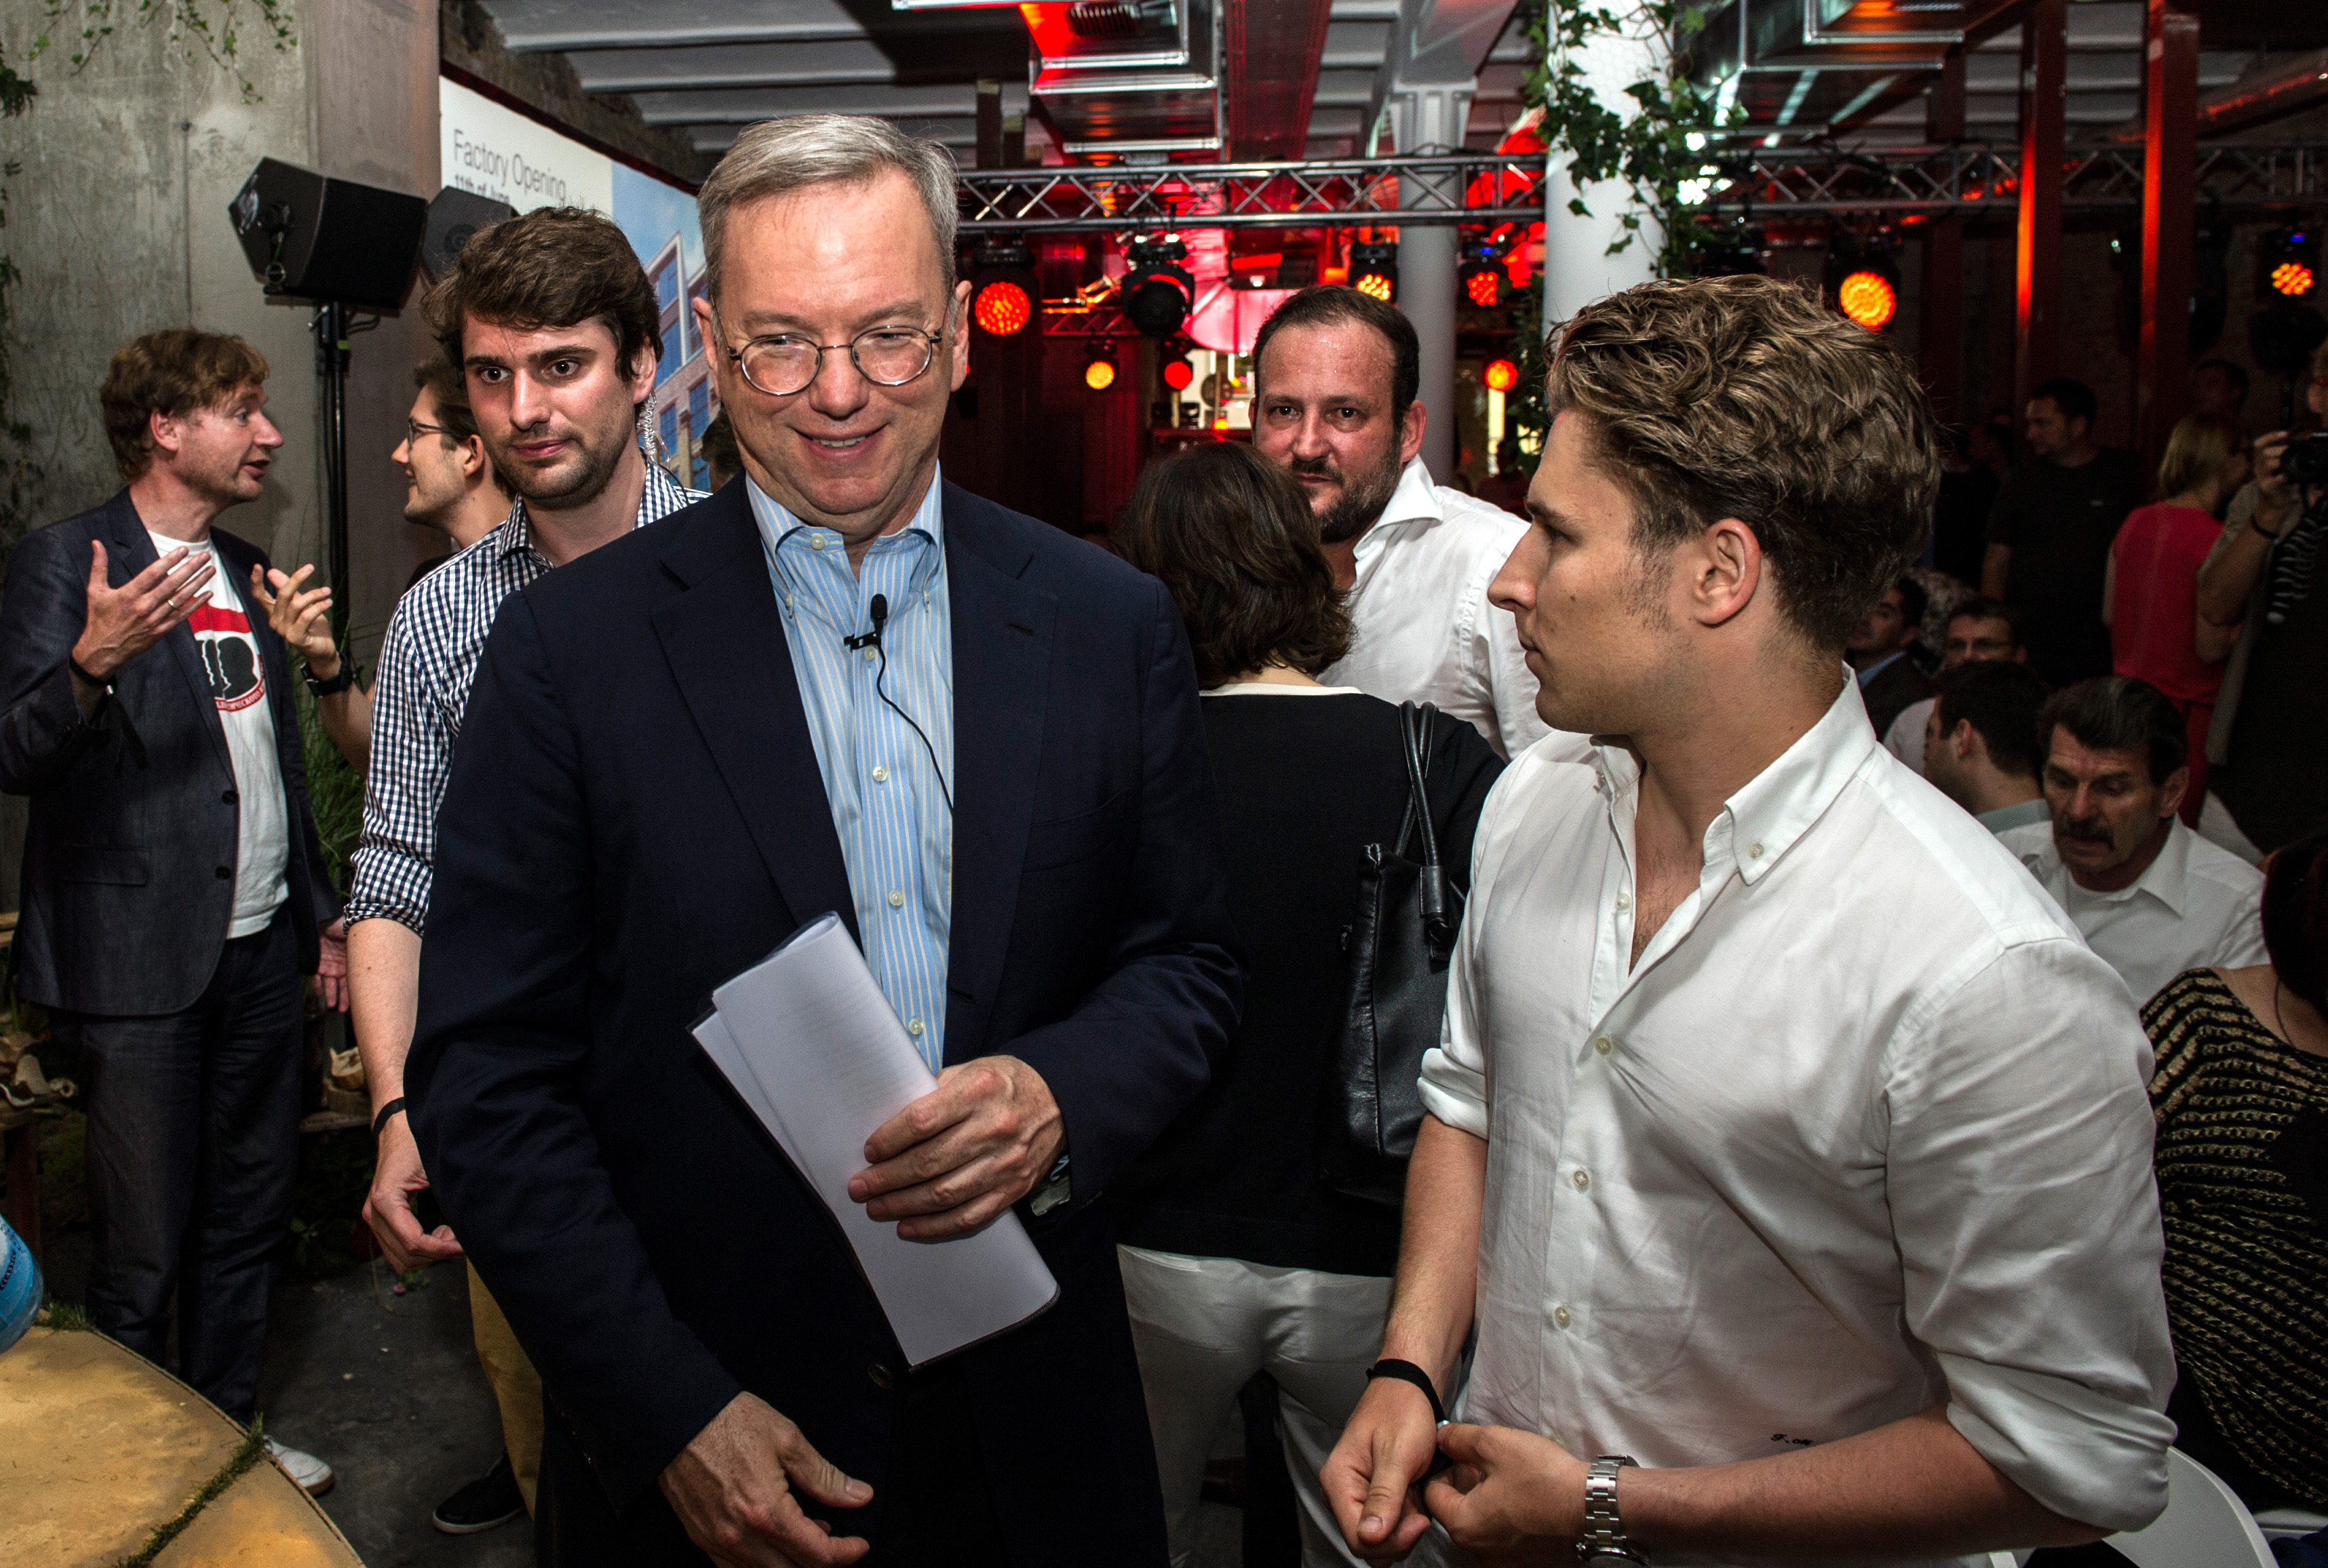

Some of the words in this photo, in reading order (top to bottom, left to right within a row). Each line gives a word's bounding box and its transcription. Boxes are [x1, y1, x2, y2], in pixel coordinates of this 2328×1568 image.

[454, 128, 509, 187] Factory
[512, 153, 566, 206] Opening
[0, 1251, 16, 1289] CLASSIC
